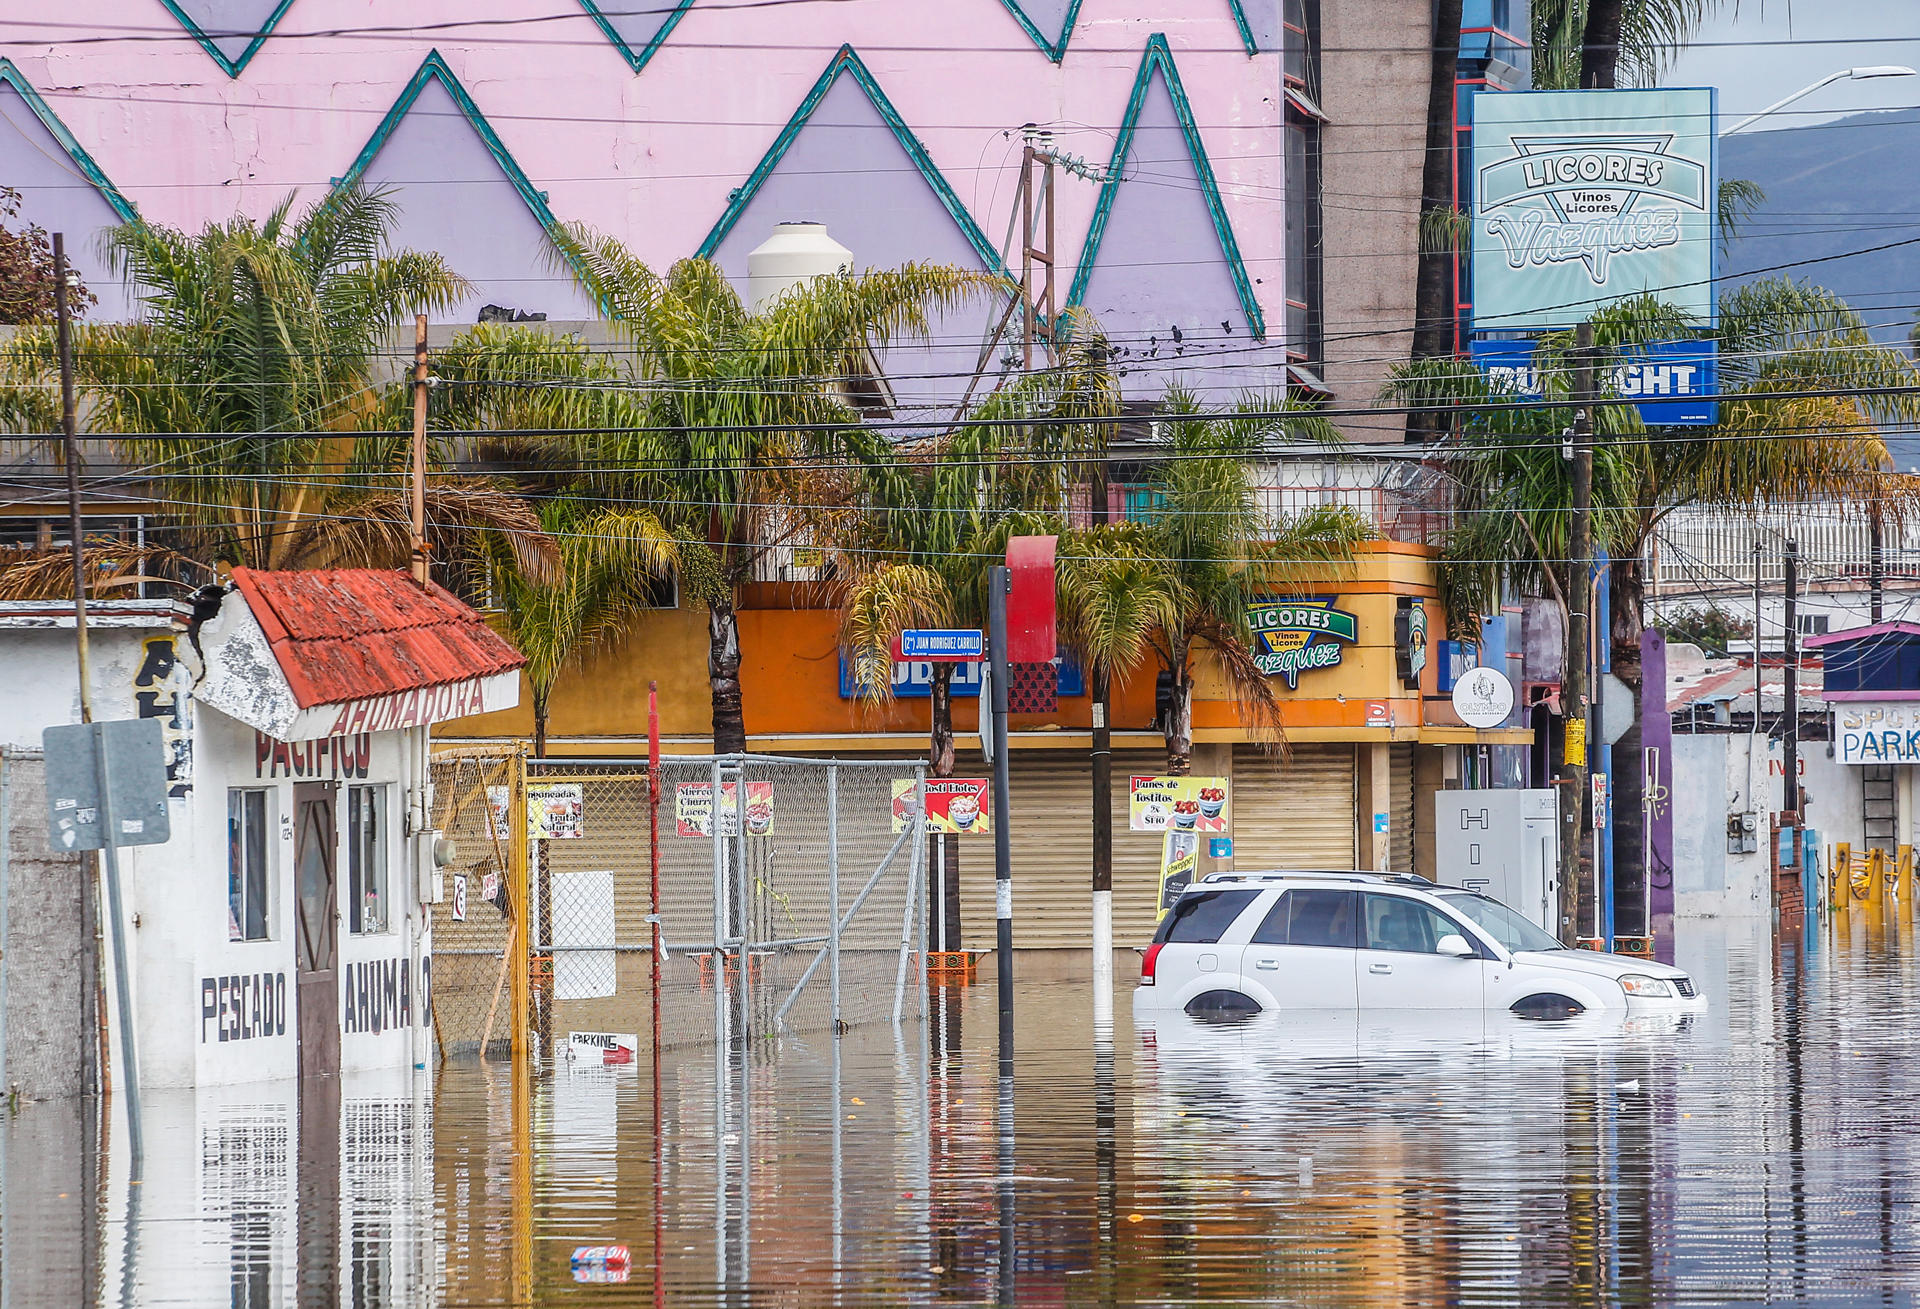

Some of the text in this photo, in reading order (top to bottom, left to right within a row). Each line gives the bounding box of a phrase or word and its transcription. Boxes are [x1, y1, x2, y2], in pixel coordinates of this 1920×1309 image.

[1523, 155, 1664, 188] LICORES
[1572, 192, 1612, 202] Vinos
[1566, 203, 1618, 213] Licores
[1487, 207, 1679, 284] Vazquez
[916, 636, 929, 650] JUAN
[930, 636, 956, 650] RODRIGUEZ
[957, 636, 980, 650] CABRILLO
[1271, 639, 1304, 647] Licores
[1252, 643, 1341, 689] azquez
[330, 677, 484, 736] AHUMADORA
[1460, 702, 1507, 712] OLYMPO
[1844, 730, 1920, 762] PARK
[1136, 780, 1178, 789] Lunes de
[1135, 793, 1173, 803] Tostitos
[550, 812, 577, 822] Fruta
[681, 808, 708, 817] Locos
[541, 822, 576, 832] Natural
[344, 955, 431, 1036] AHUMAO
[201, 972, 286, 1044] PESCADO
[572, 1033, 618, 1050] PARKING
